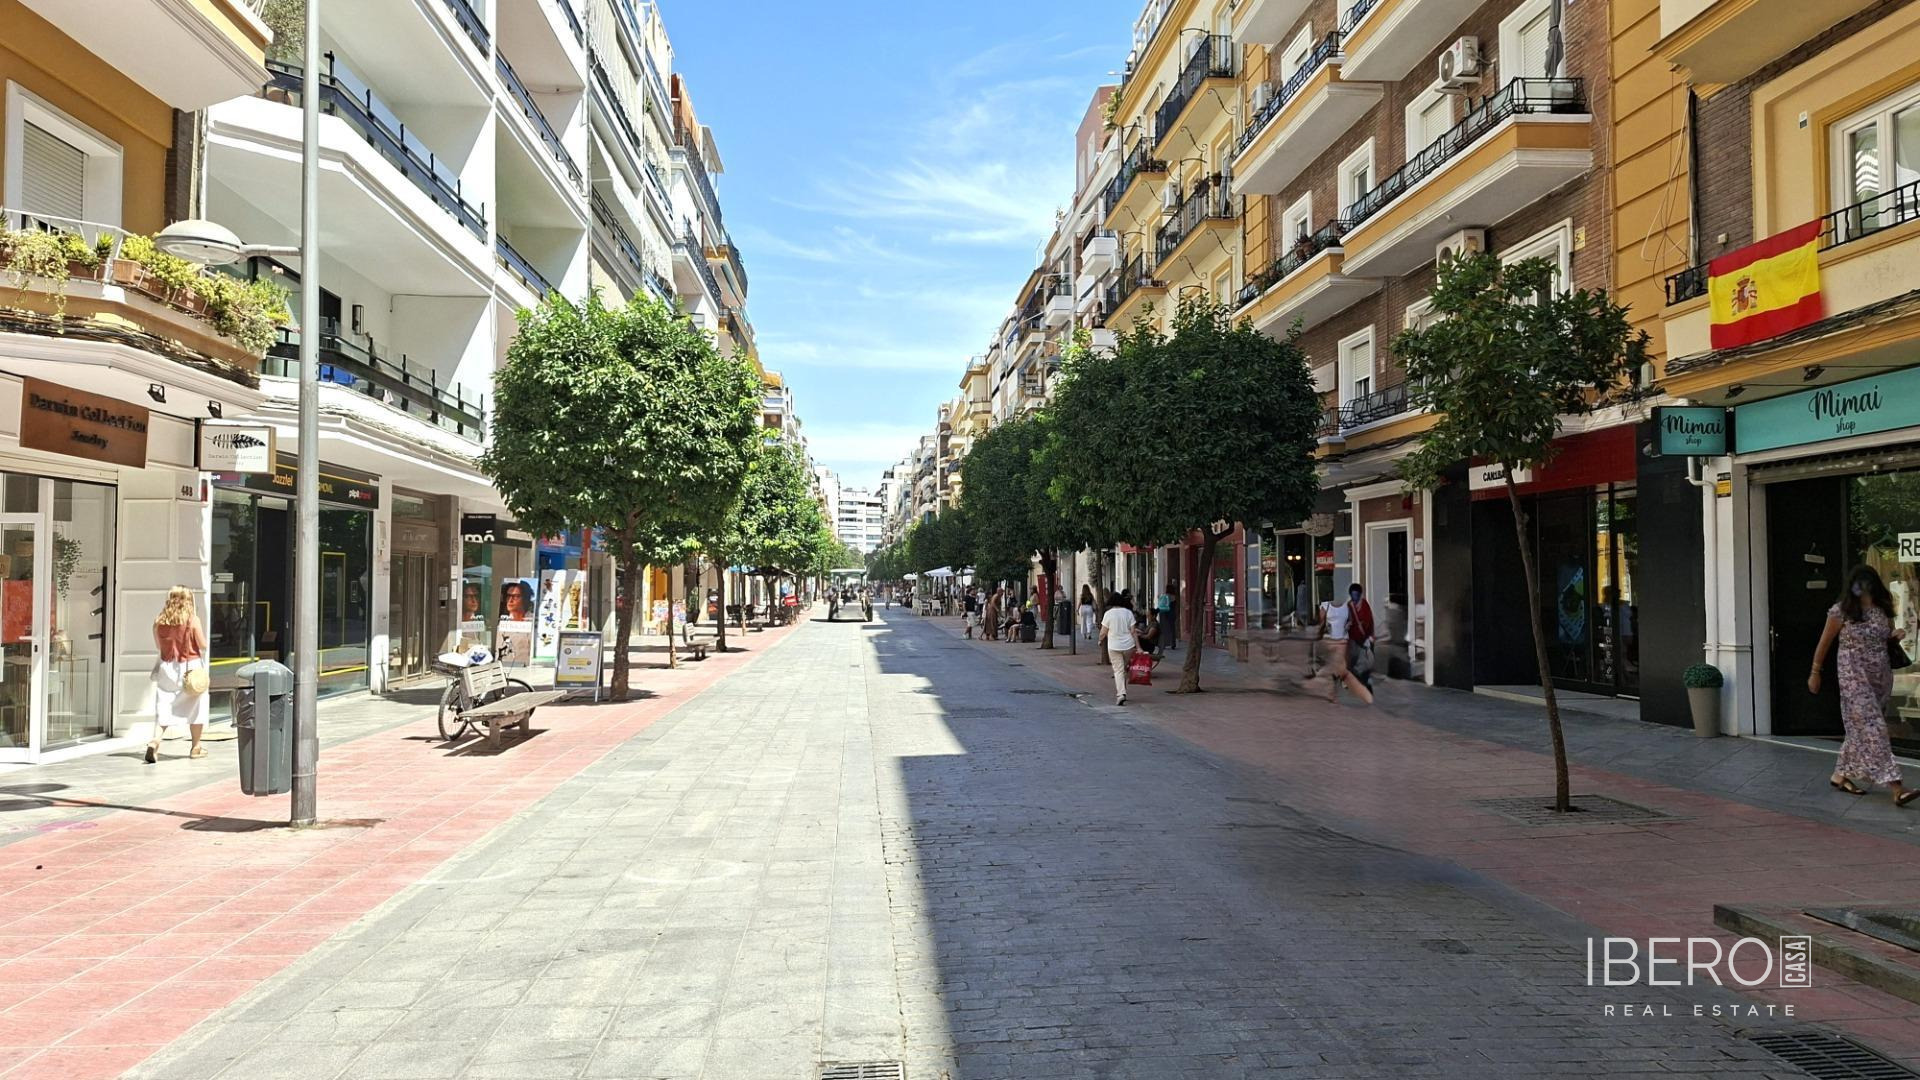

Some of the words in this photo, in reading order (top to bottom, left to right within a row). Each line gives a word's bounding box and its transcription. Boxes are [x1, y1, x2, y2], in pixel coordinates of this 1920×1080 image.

[1808, 384, 1883, 421] Mimai
[31, 393, 79, 417] Darwin
[81, 406, 147, 434] Collection
[1660, 414, 1725, 435] Mimai
[1836, 417, 1856, 434] shop
[1685, 435, 1702, 447] shop
[1482, 470, 1505, 482] CANIBA
